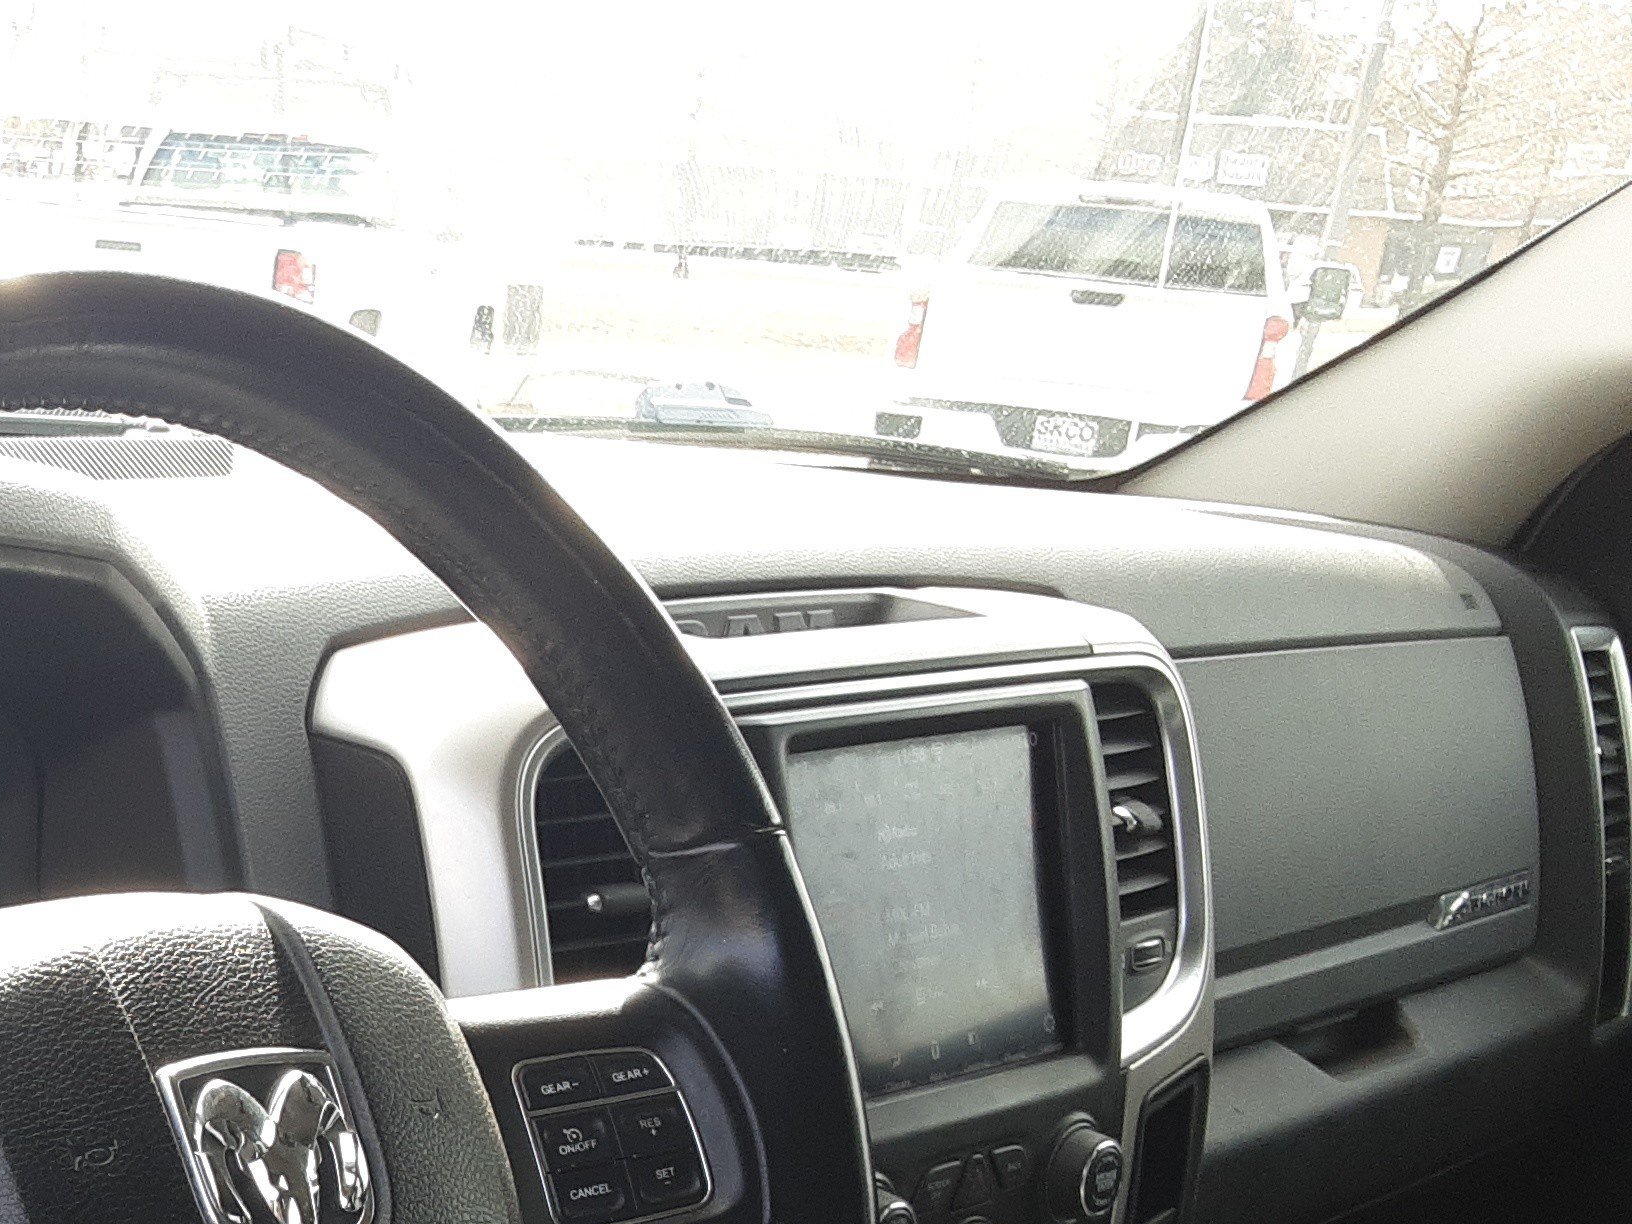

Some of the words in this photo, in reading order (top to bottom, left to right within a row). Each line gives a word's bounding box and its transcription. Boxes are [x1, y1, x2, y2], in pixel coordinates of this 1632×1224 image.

[1036, 419, 1095, 442] SKCO
[558, 1139, 597, 1156] ON/OFF
[655, 1166, 675, 1180] SET
[569, 1183, 612, 1201] CANCEL
